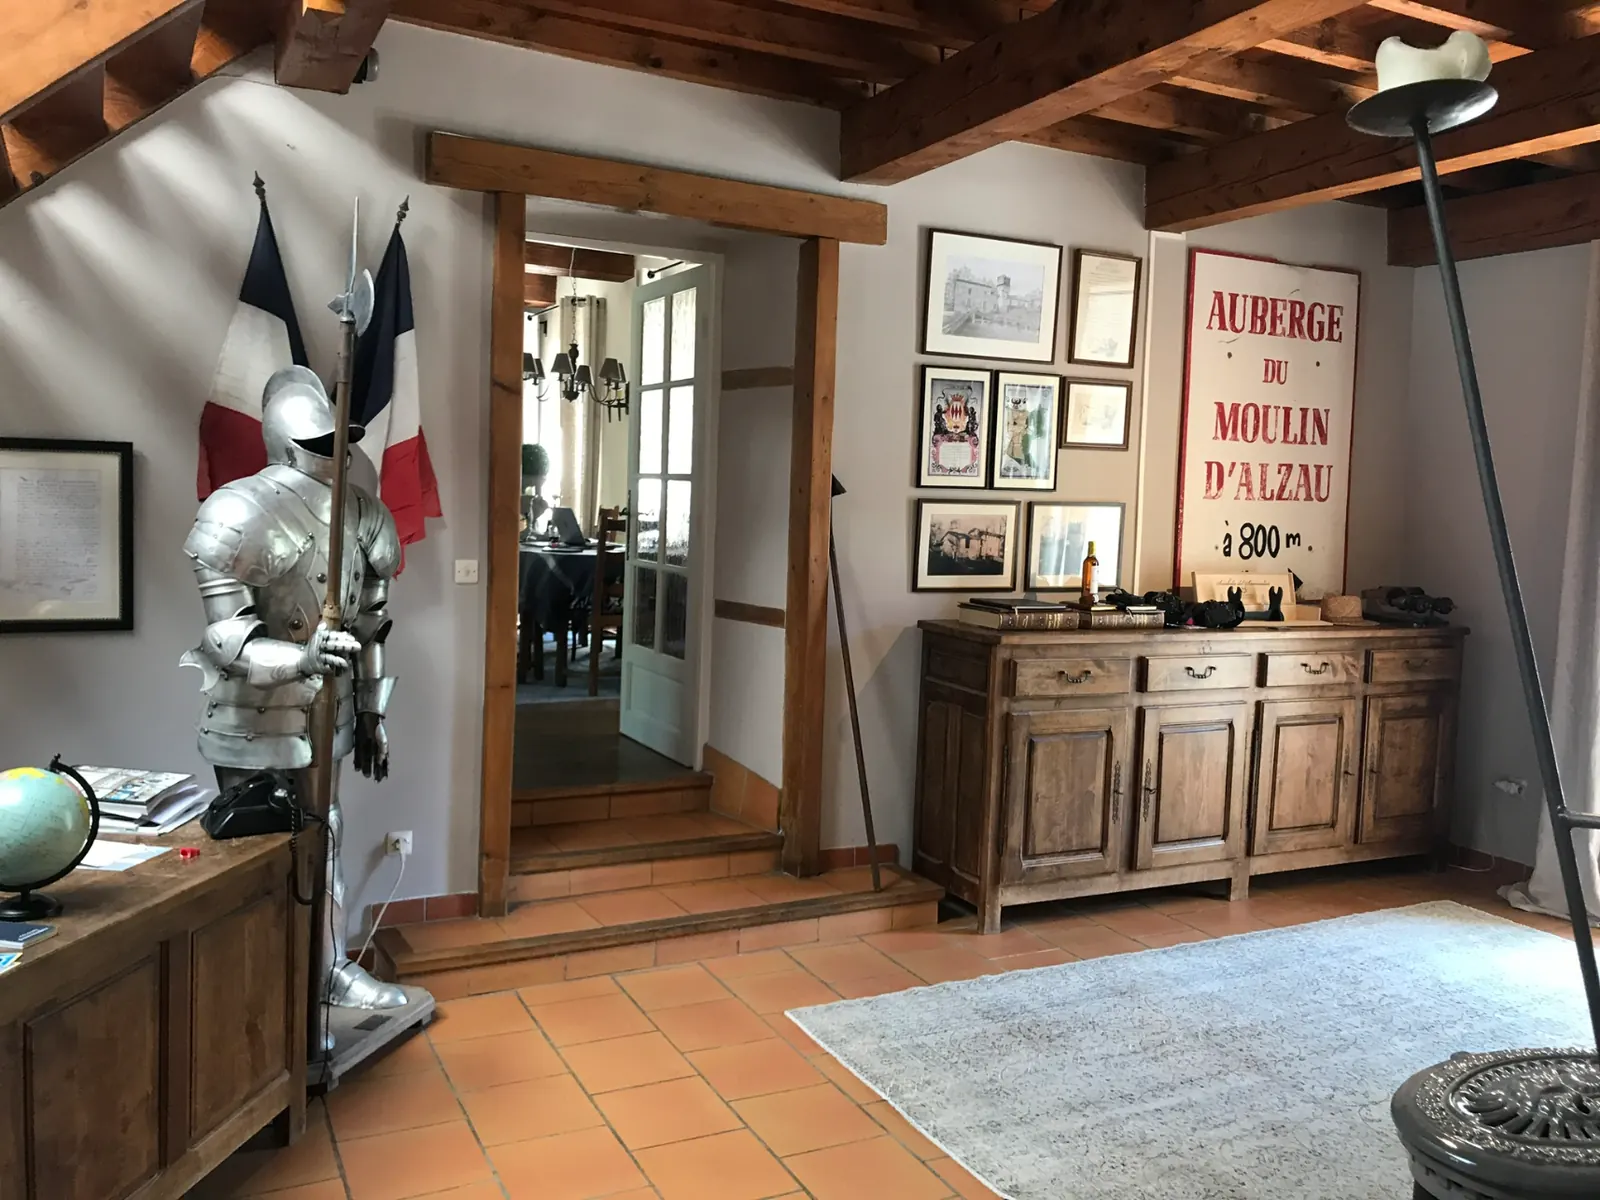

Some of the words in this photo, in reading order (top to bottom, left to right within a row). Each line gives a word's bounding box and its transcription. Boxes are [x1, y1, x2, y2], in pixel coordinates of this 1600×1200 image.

[1206, 290, 1344, 343] AUBERGE
[1262, 358, 1289, 385] DU
[1212, 401, 1330, 446] MOULIN
[1202, 461, 1334, 503] D'ALZAU
[1222, 519, 1232, 557] à
[1238, 522, 1281, 560] 800
[1285, 532, 1301, 548] m
